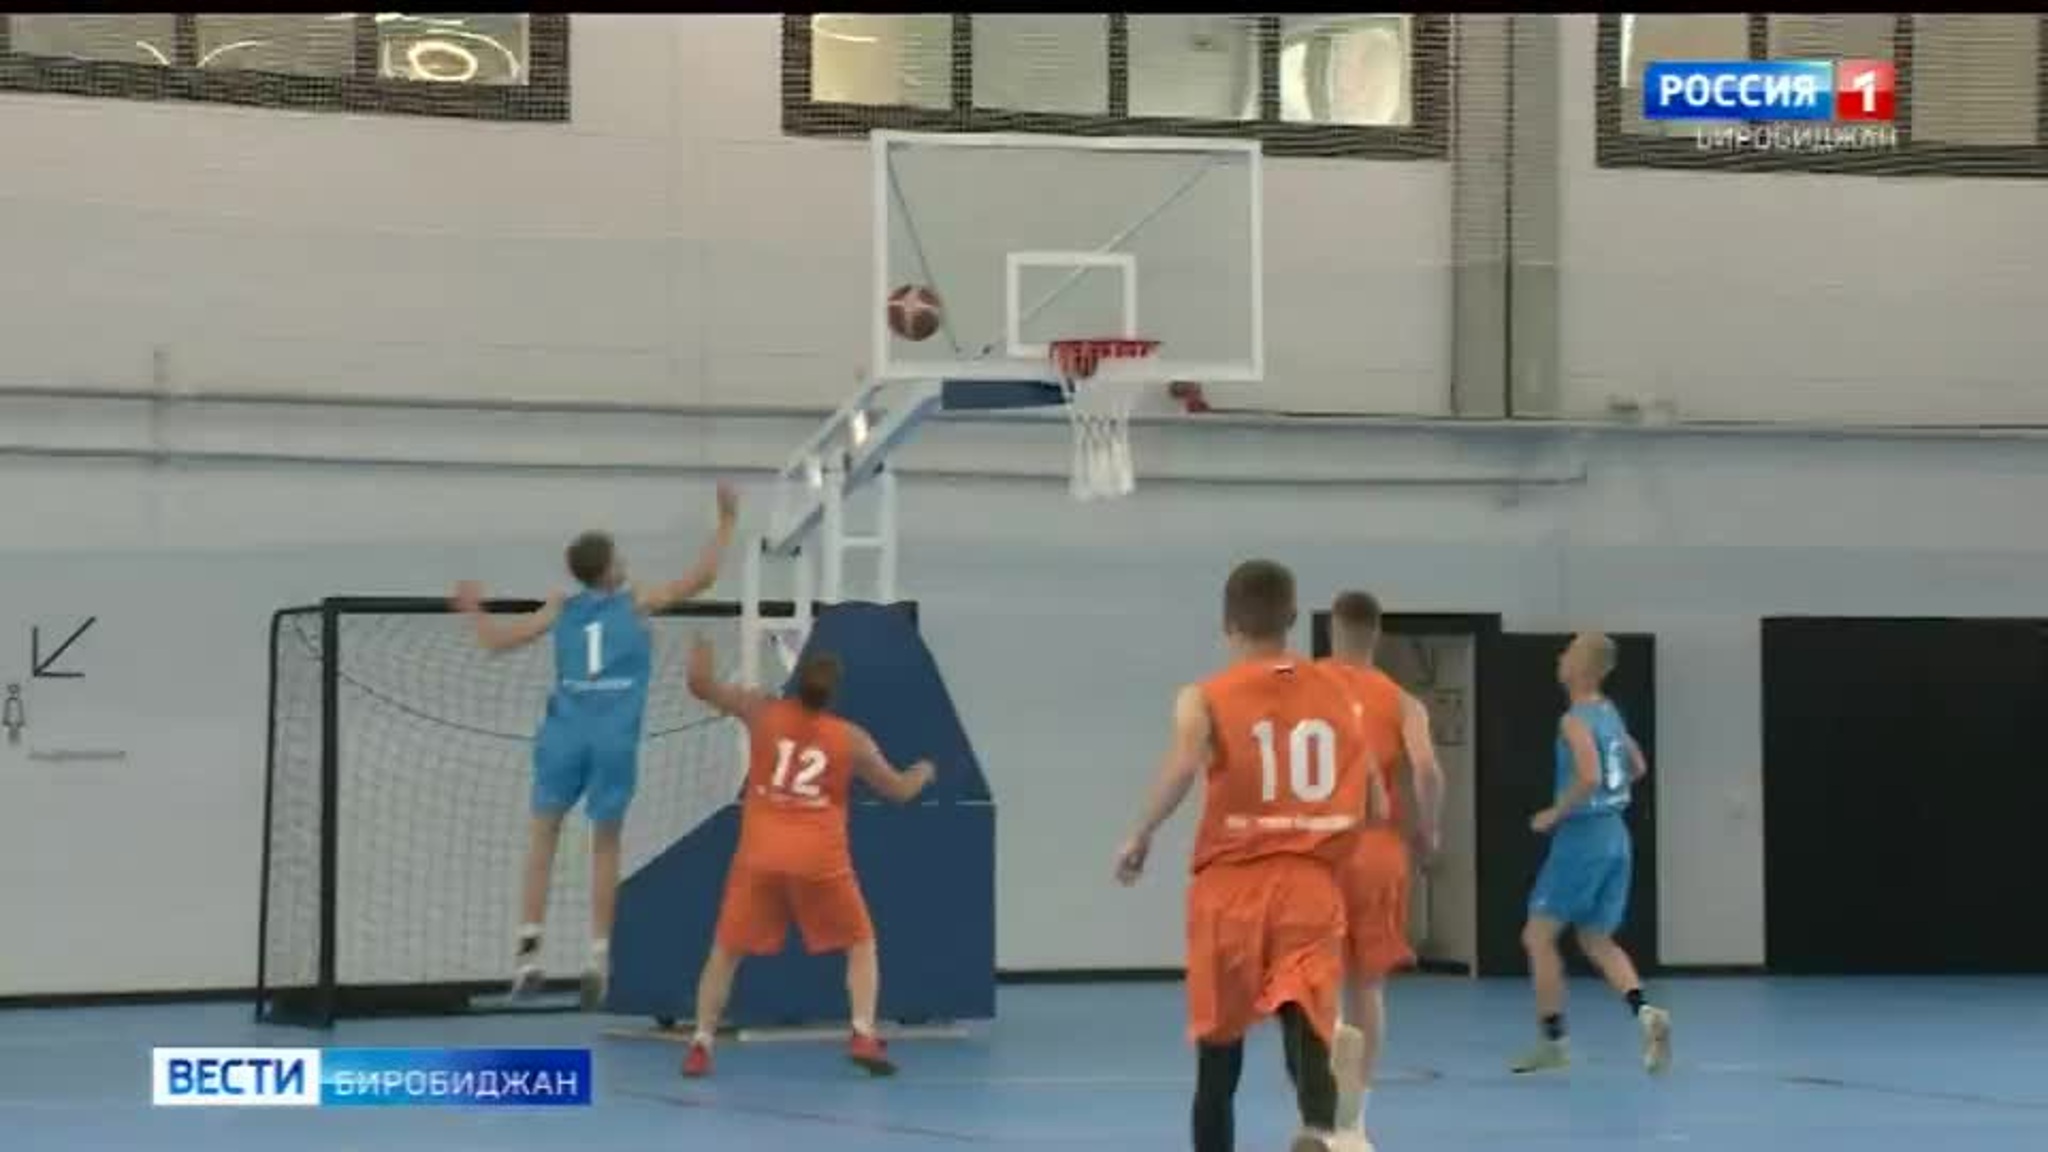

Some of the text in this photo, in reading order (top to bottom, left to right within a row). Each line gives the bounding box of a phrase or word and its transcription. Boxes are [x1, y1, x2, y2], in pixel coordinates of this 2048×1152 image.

[583, 621, 602, 674] 1
[772, 738, 828, 795] 12
[1253, 718, 1336, 802] 10
